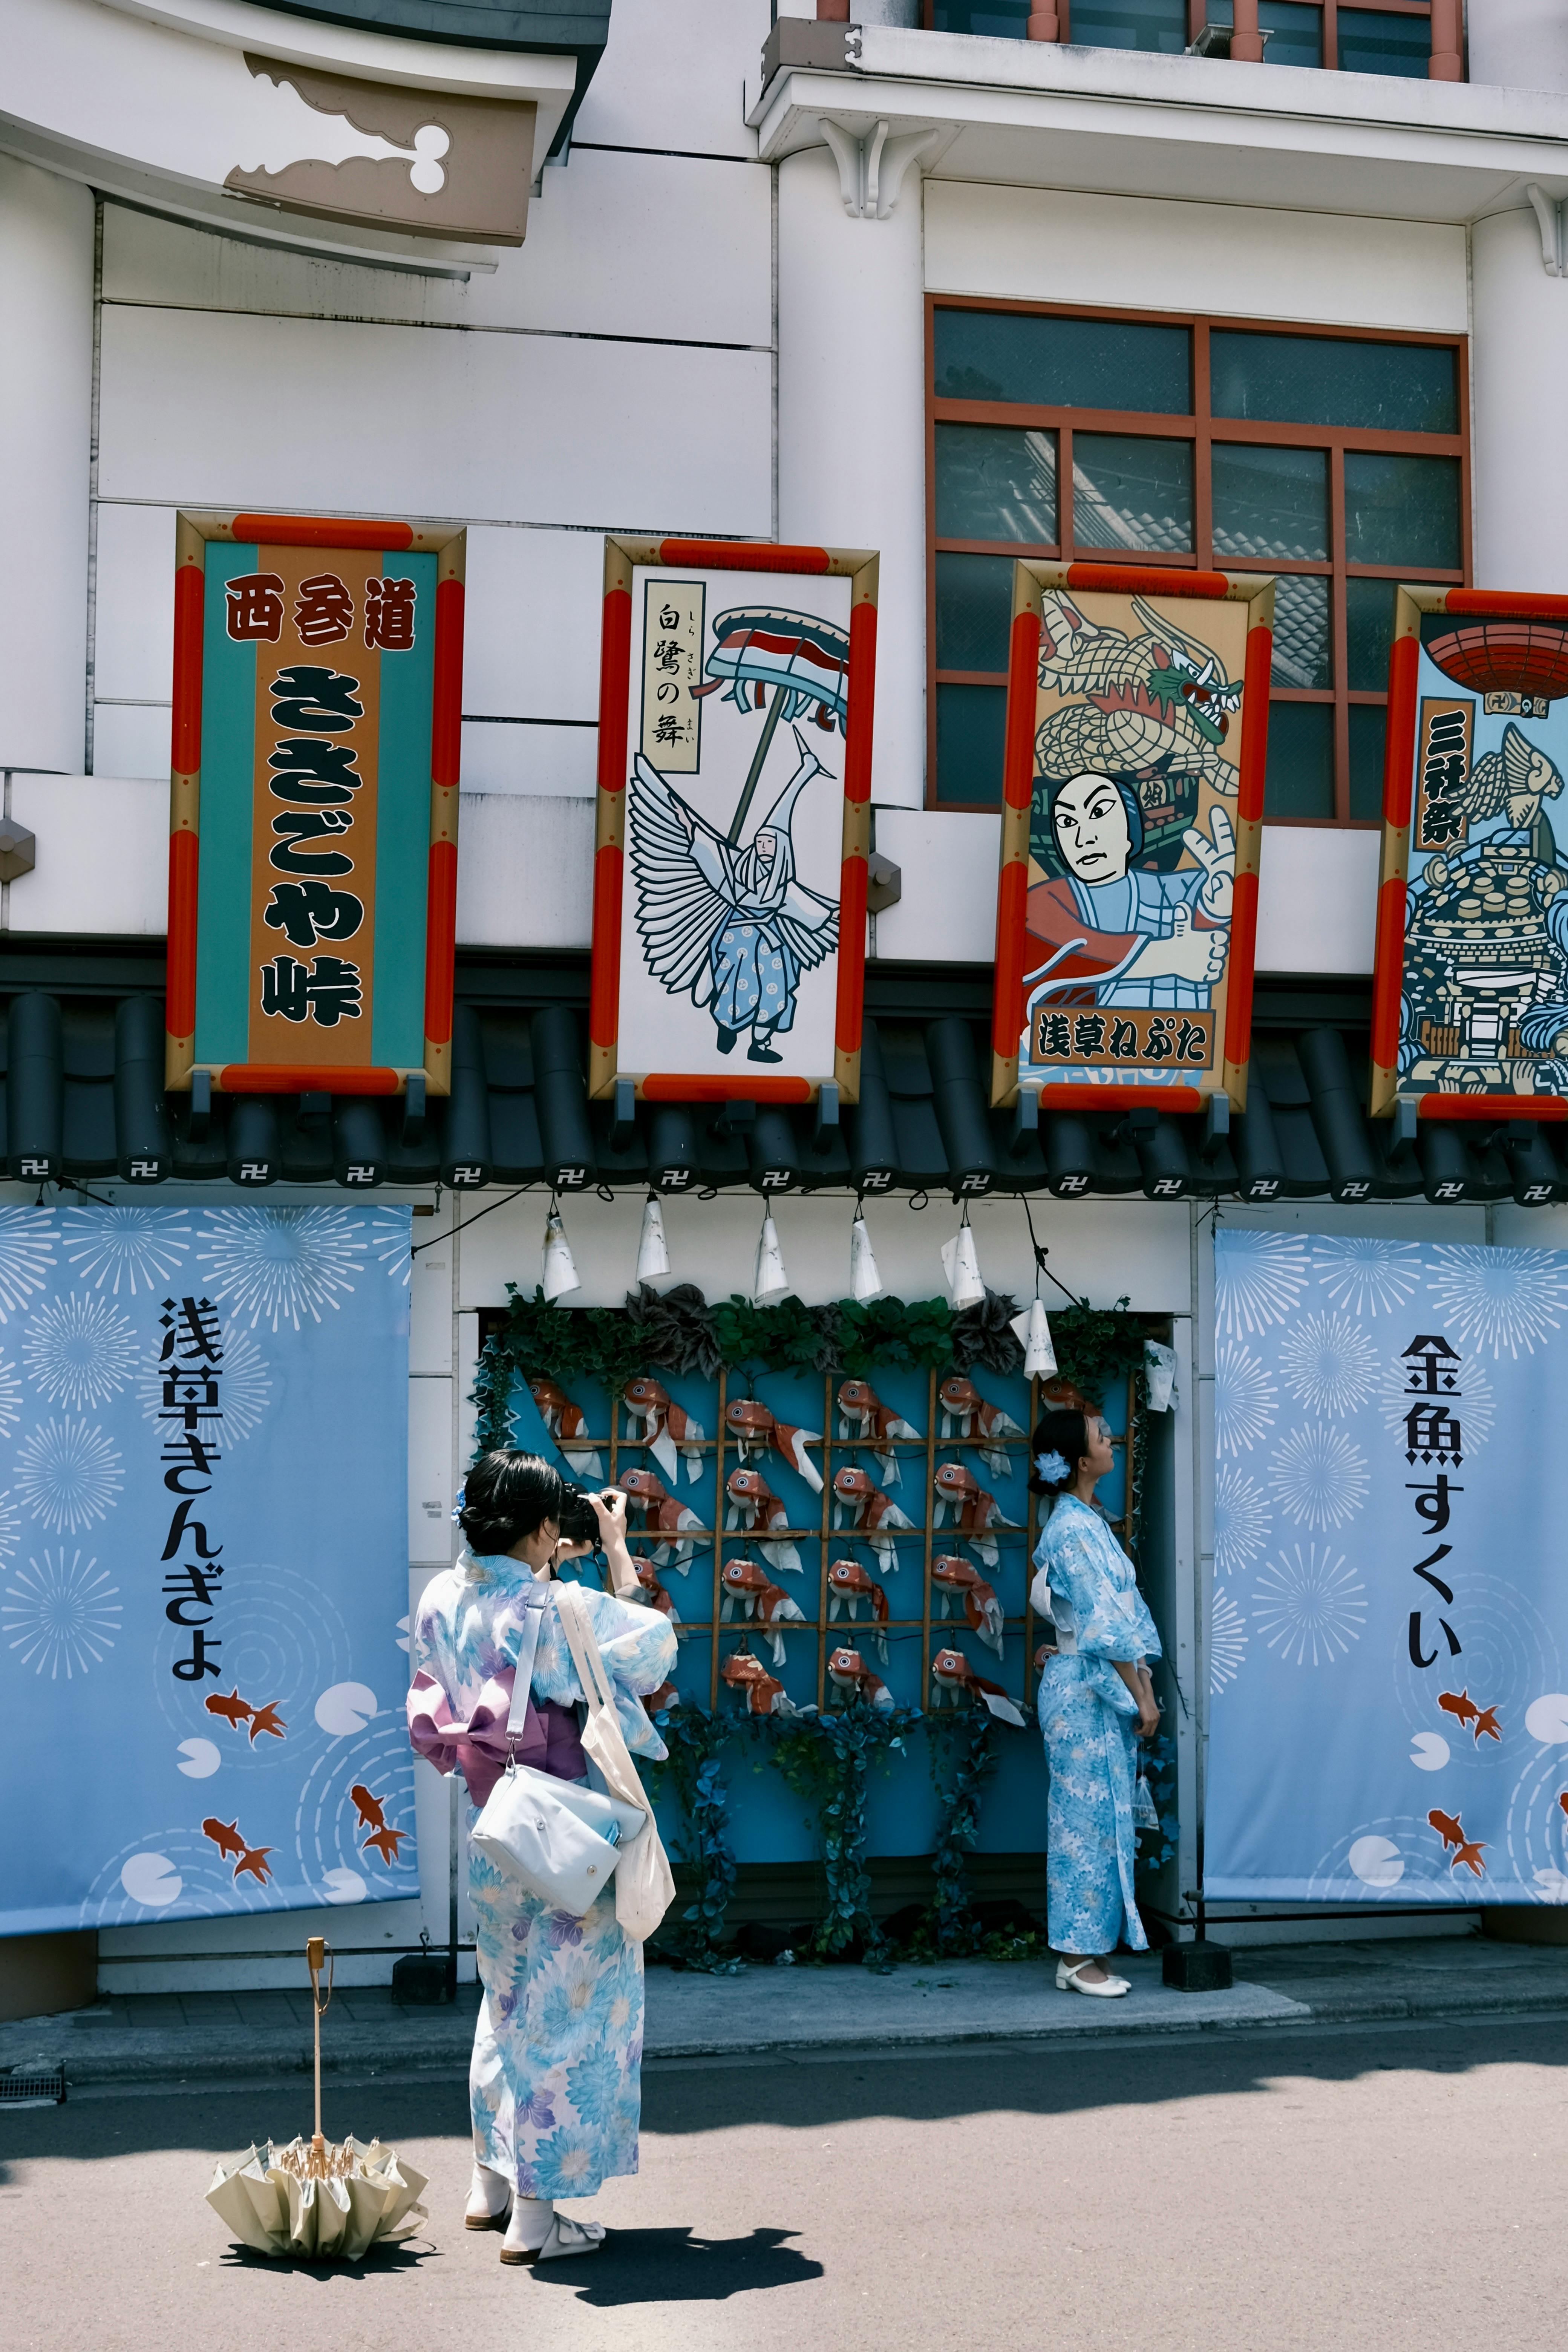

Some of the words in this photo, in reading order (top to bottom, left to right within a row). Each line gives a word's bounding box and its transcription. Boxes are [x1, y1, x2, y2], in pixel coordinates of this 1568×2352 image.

[224, 573, 417, 651] 西参道
[652, 604, 686, 748] 白鷺の舞
[1421, 709, 1467, 845] 三社祭
[1038, 1012, 1206, 1062] 浅草ねぷた
[158, 1297, 225, 1681] 浅草きんぎょ
[1401, 1335, 1464, 1668] 金魚すくい
